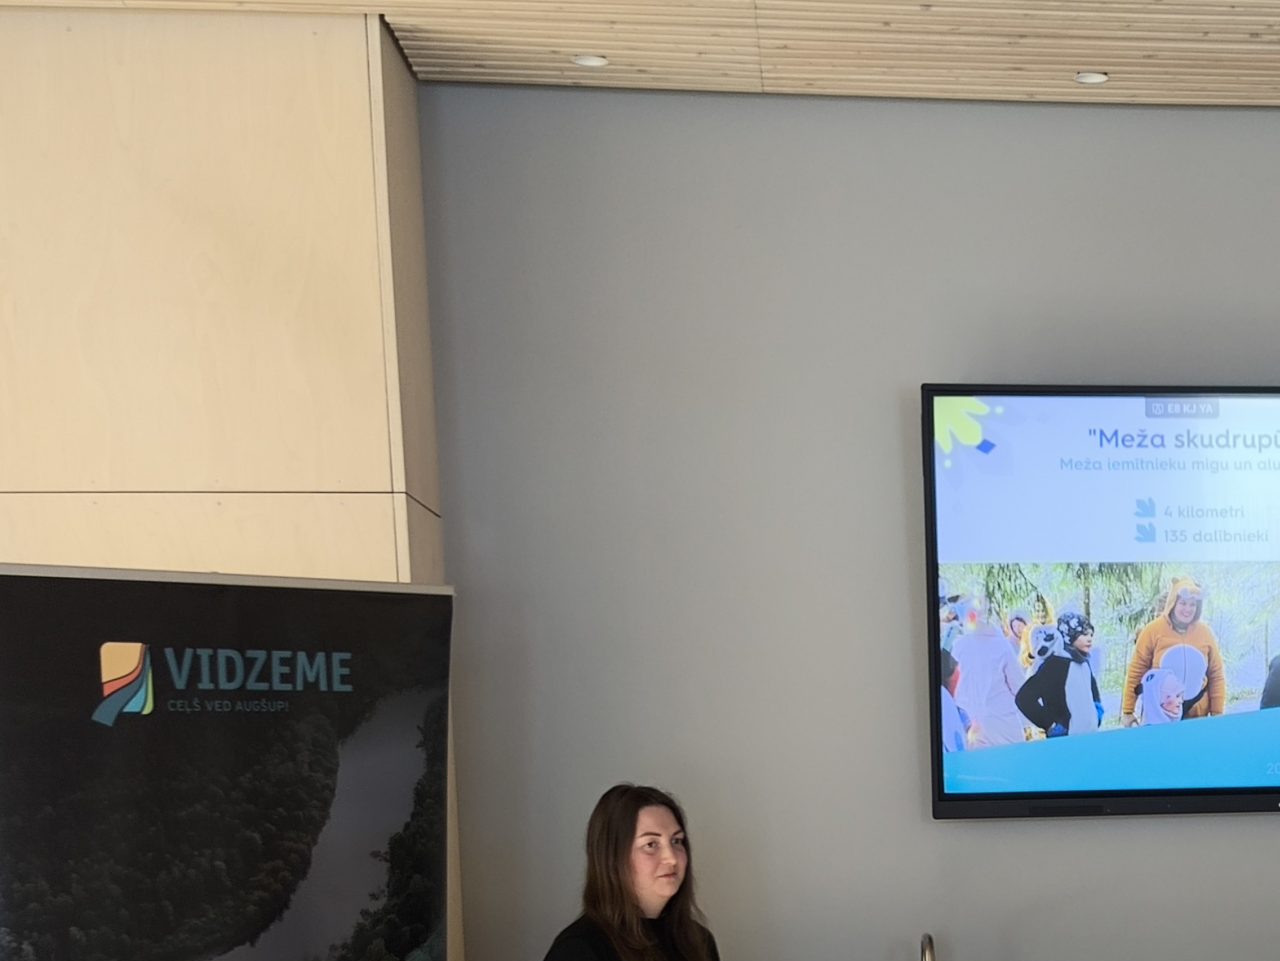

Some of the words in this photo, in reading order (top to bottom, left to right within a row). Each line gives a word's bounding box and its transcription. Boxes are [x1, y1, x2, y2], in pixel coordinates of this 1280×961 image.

[1088, 428, 1166, 448] "Meža
[1233, 460, 1253, 471] un
[1163, 505, 1173, 518] 4
[1178, 505, 1245, 518] kilometri
[1164, 530, 1188, 543] 135
[164, 647, 353, 692] VIDZEME
[168, 697, 201, 714] CEĻŠ
[206, 700, 232, 712] VED
